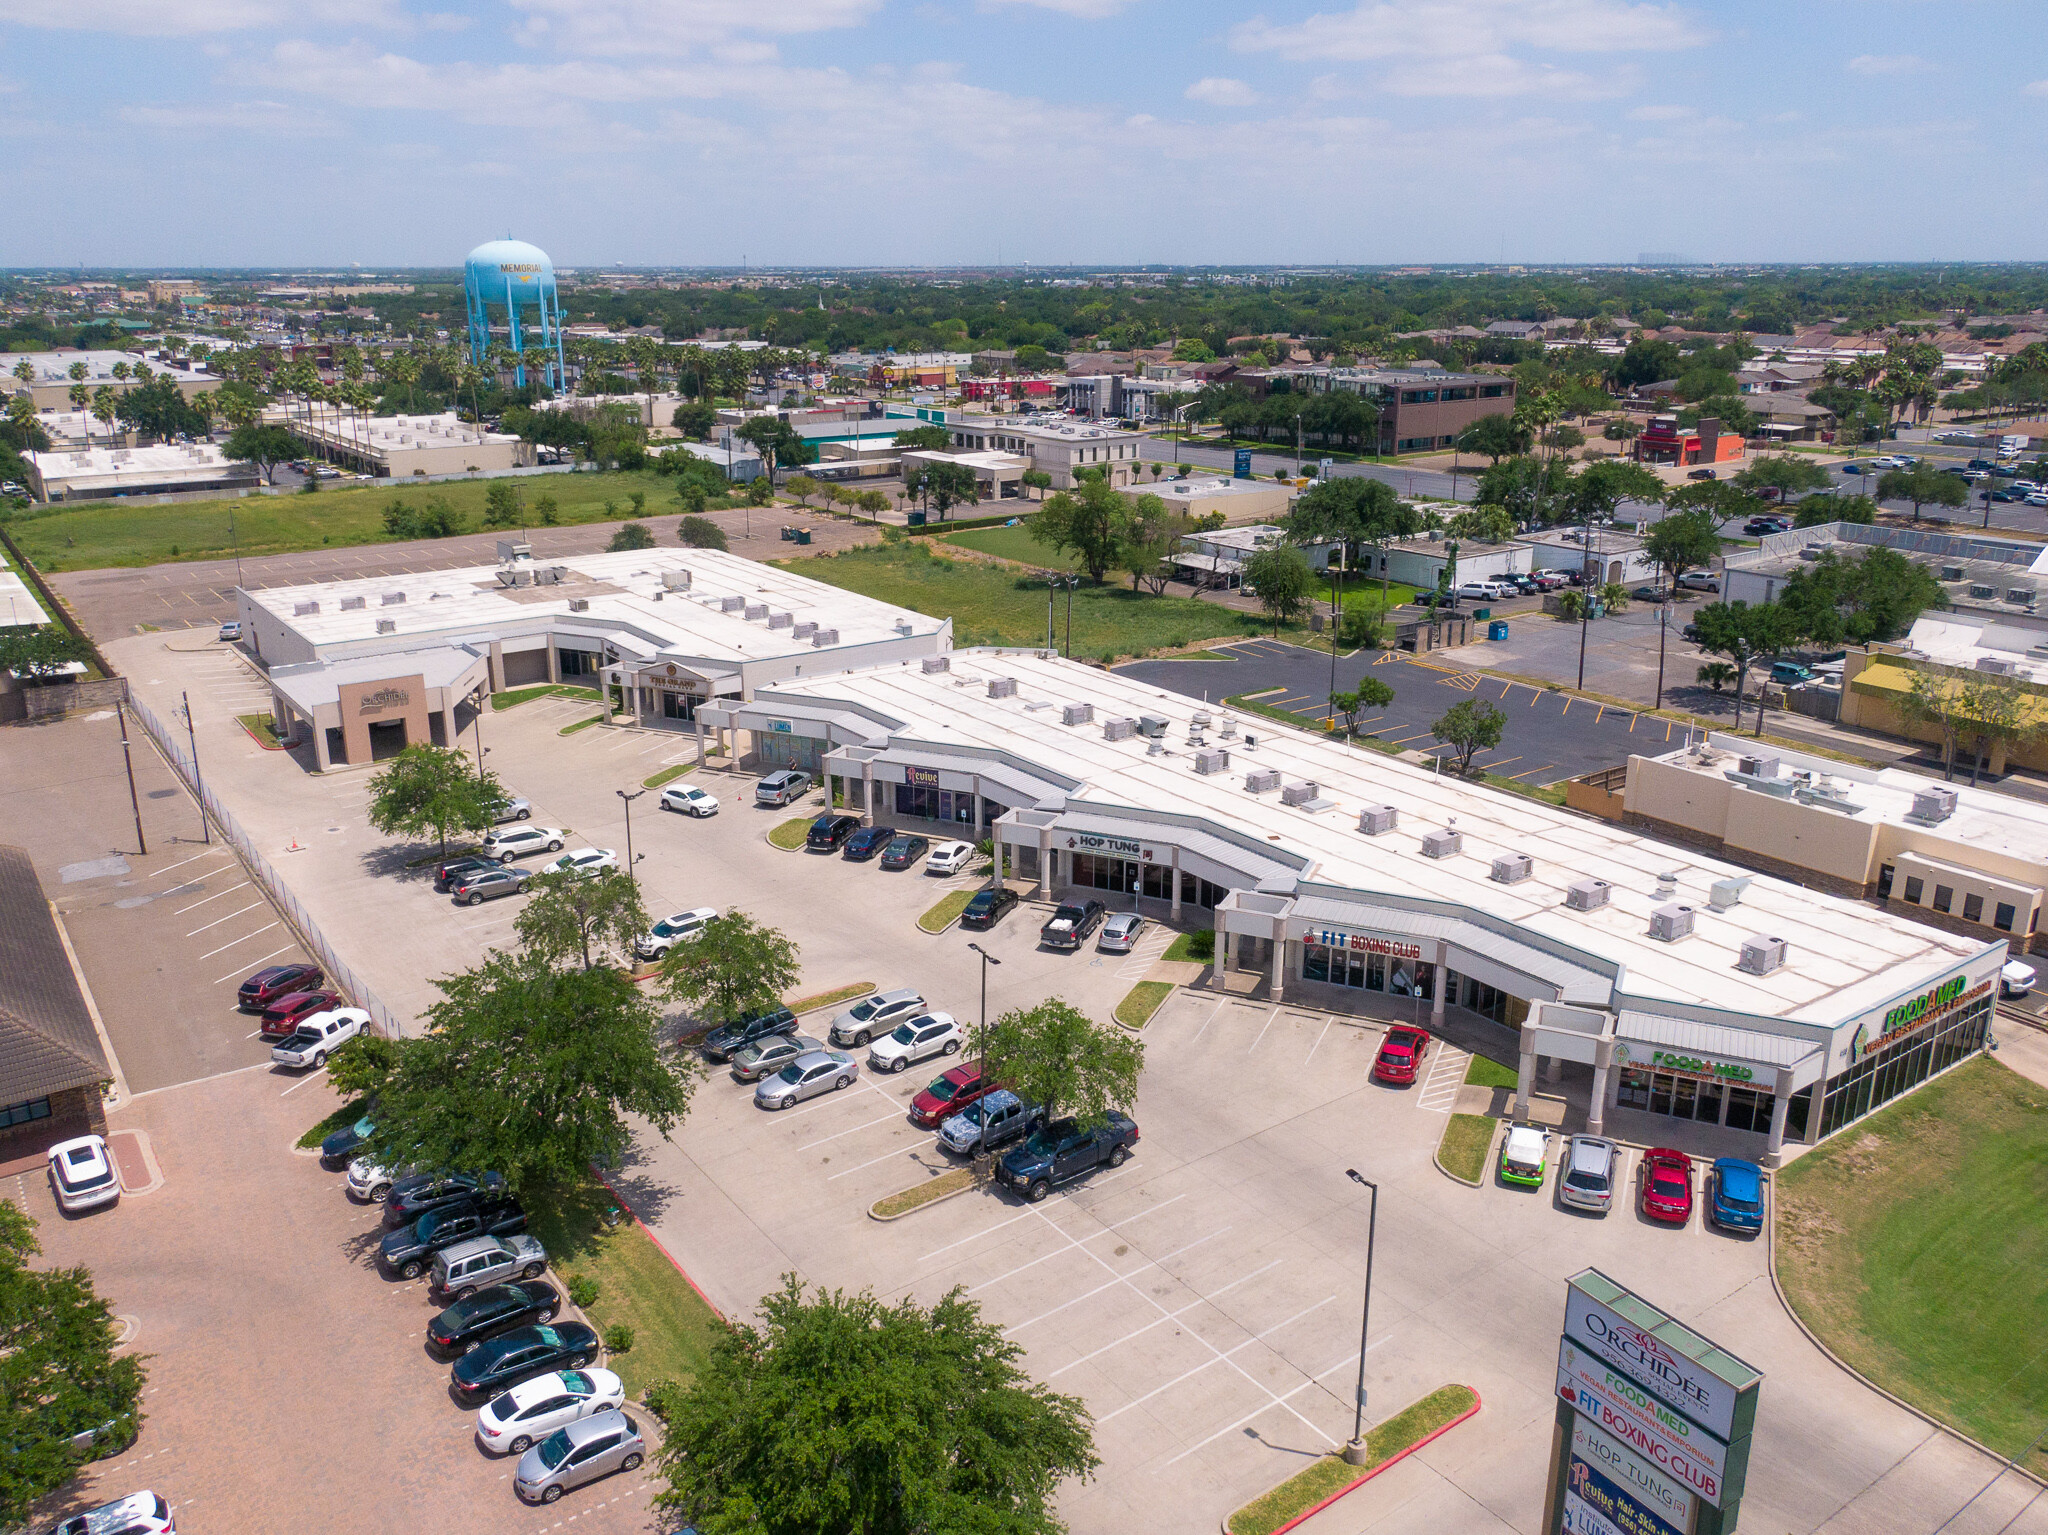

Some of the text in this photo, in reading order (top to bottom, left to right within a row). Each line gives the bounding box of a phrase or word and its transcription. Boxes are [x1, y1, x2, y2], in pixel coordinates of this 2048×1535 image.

[500, 264, 542, 272] MEMORIAL
[906, 767, 937, 782] Revive
[1080, 836, 1140, 853] HOP TUNG
[1322, 930, 1420, 959] FIT BOXING CLUB
[1884, 974, 1967, 1033] FOODAMED
[1863, 1031, 1894, 1055] VEGAN
[1894, 1005, 1944, 1039] RESTAURANT
[1628, 1060, 1657, 1071] VEGAN
[1658, 1065, 1715, 1083] RESTAURANT
[1724, 1077, 1774, 1093] EMPORIUM
[1653, 1051, 1753, 1081] FOODAMED
[1585, 1313, 1710, 1408] ORCHIDÉE
[1580, 1371, 1605, 1393] VEGAN
[1604, 1372, 1689, 1437] FOODAMED
[1579, 1389, 1717, 1497] FIT BOXING CLUB
[1570, 1462, 1614, 1510] Revive
[1588, 1435, 1621, 1464] HOP
[1627, 1461, 1673, 1505] TUNG
[1617, 1496, 1635, 1518] Hair
[1637, 1512, 1656, 1534] Skin
[1617, 1512, 1637, 1534] (956)
